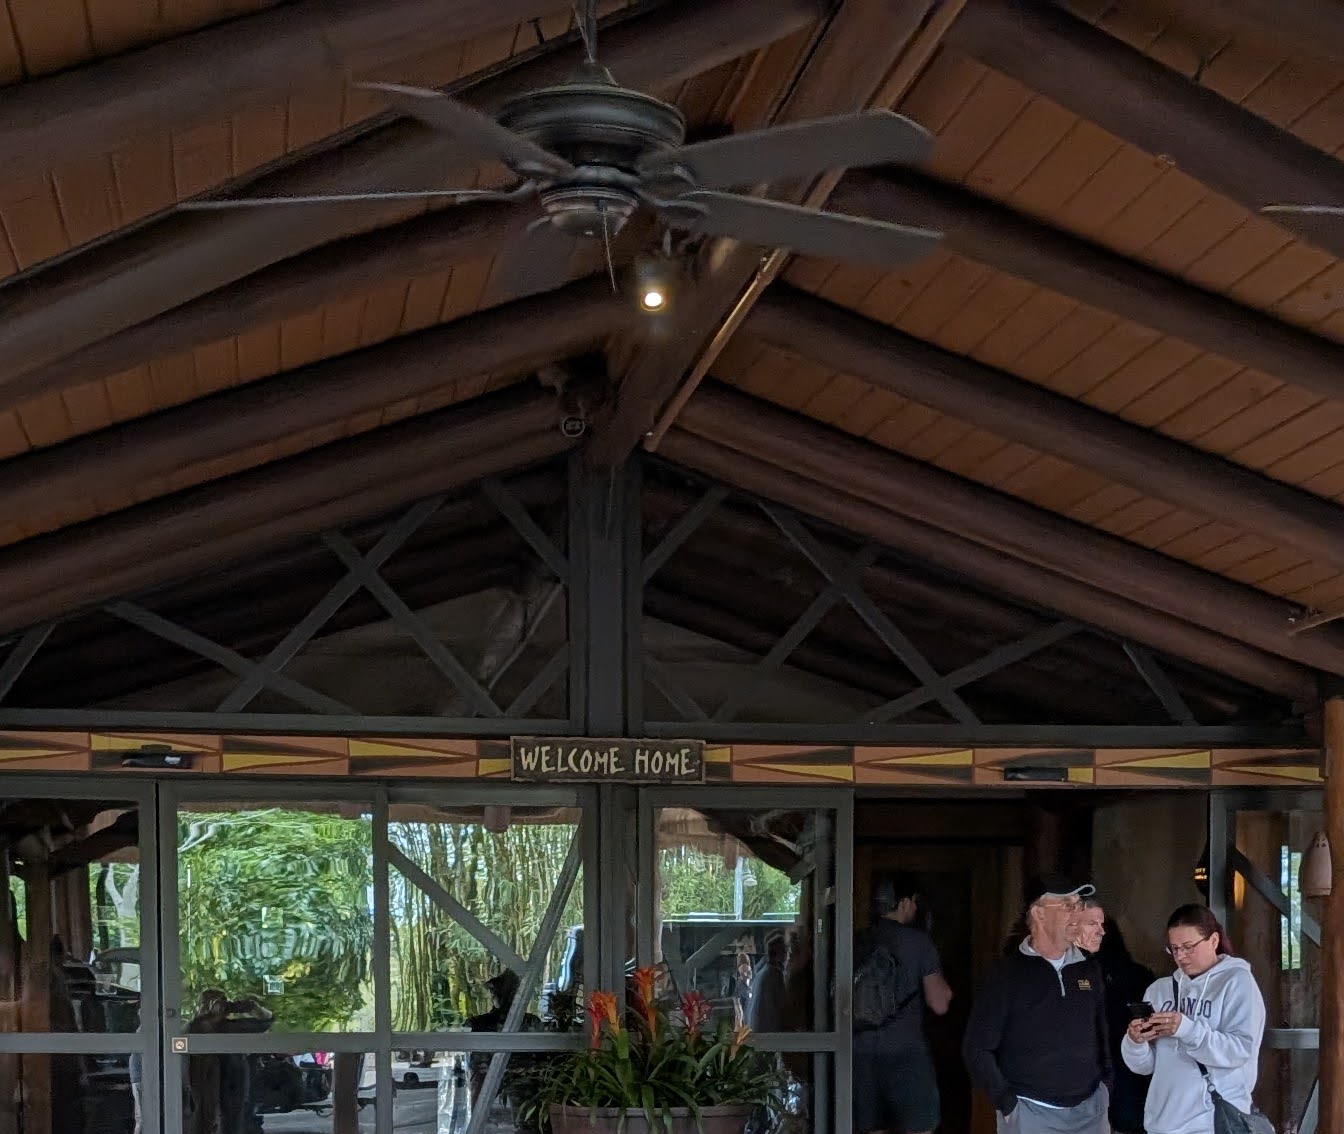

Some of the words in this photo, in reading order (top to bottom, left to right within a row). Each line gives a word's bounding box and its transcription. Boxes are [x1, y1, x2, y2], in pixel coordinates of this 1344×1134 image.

[520, 745, 625, 775] WELCOME
[635, 748, 696, 776] HOME
[1160, 997, 1212, 1018] ONDO
